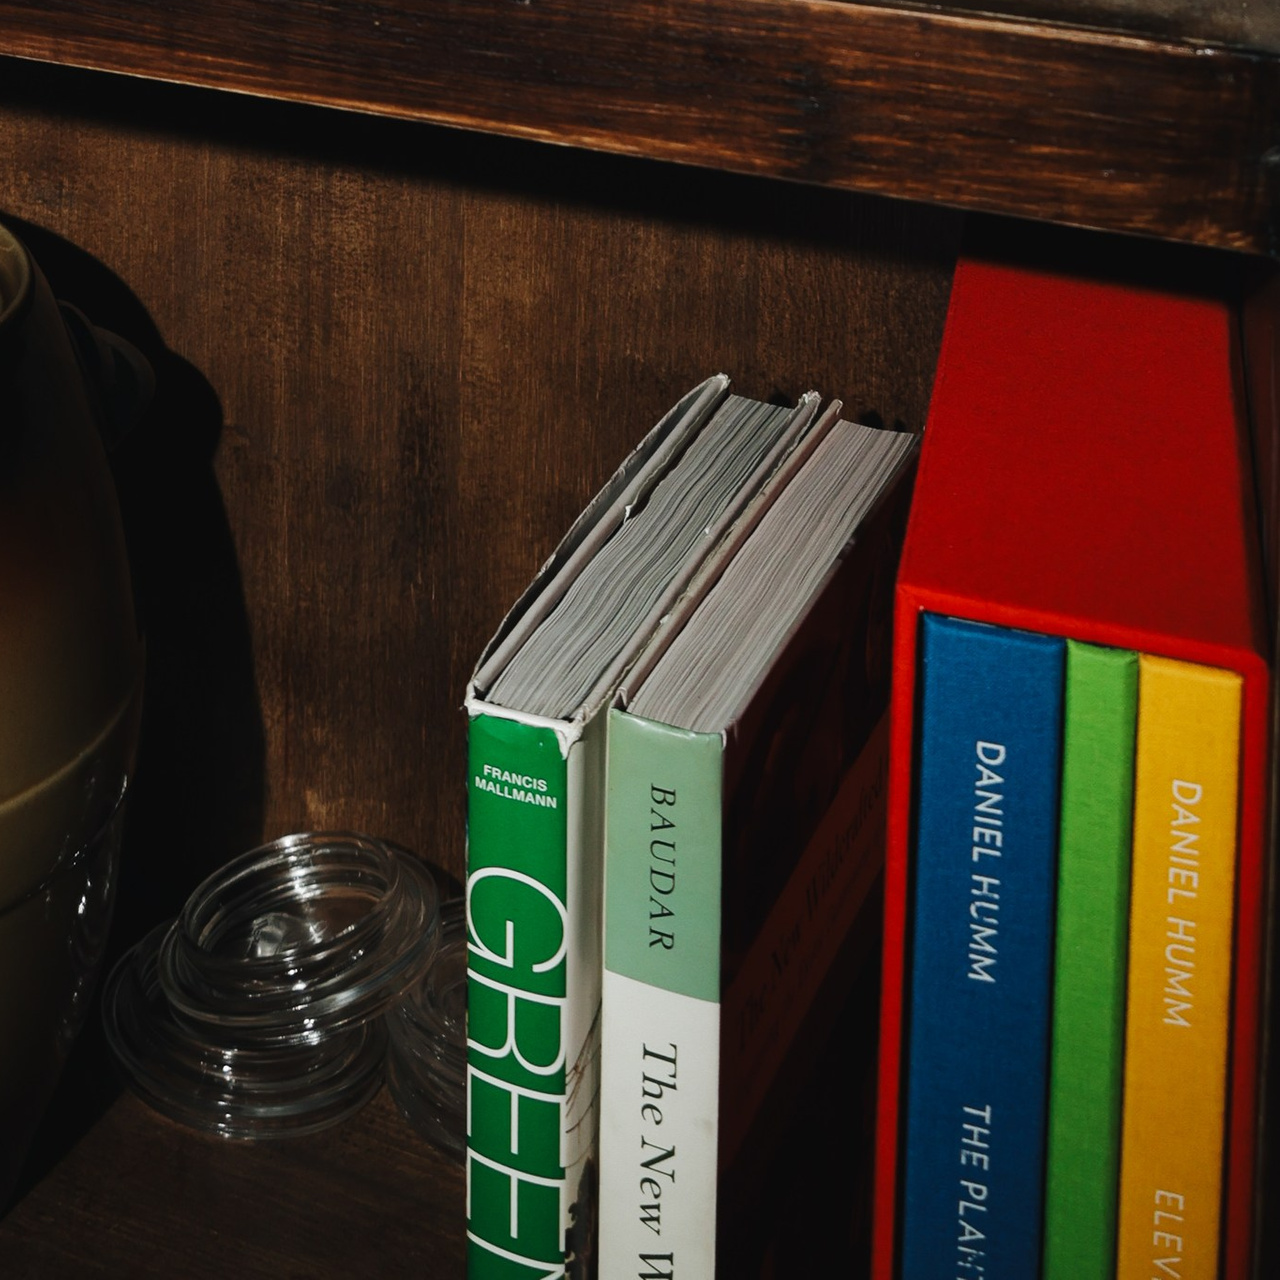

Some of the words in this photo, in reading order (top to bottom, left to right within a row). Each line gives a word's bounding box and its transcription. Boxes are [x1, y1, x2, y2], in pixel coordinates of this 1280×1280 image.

[475, 775, 558, 810] MALLMANN
[483, 763, 548, 793] FRANCIS
[971, 740, 1006, 866] DANIEL
[648, 782, 678, 952] BAUDAR
[1170, 778, 1204, 906] DANIEL
[967, 874, 1000, 985] HUMM
[1162, 914, 1197, 1030] HUMM
[641, 1041, 679, 1127] The
[639, 1136, 675, 1237] New
[959, 1104, 992, 1172] THE
[955, 1179, 989, 1280] PLAN
[1151, 1189, 1185, 1280] ELEV
